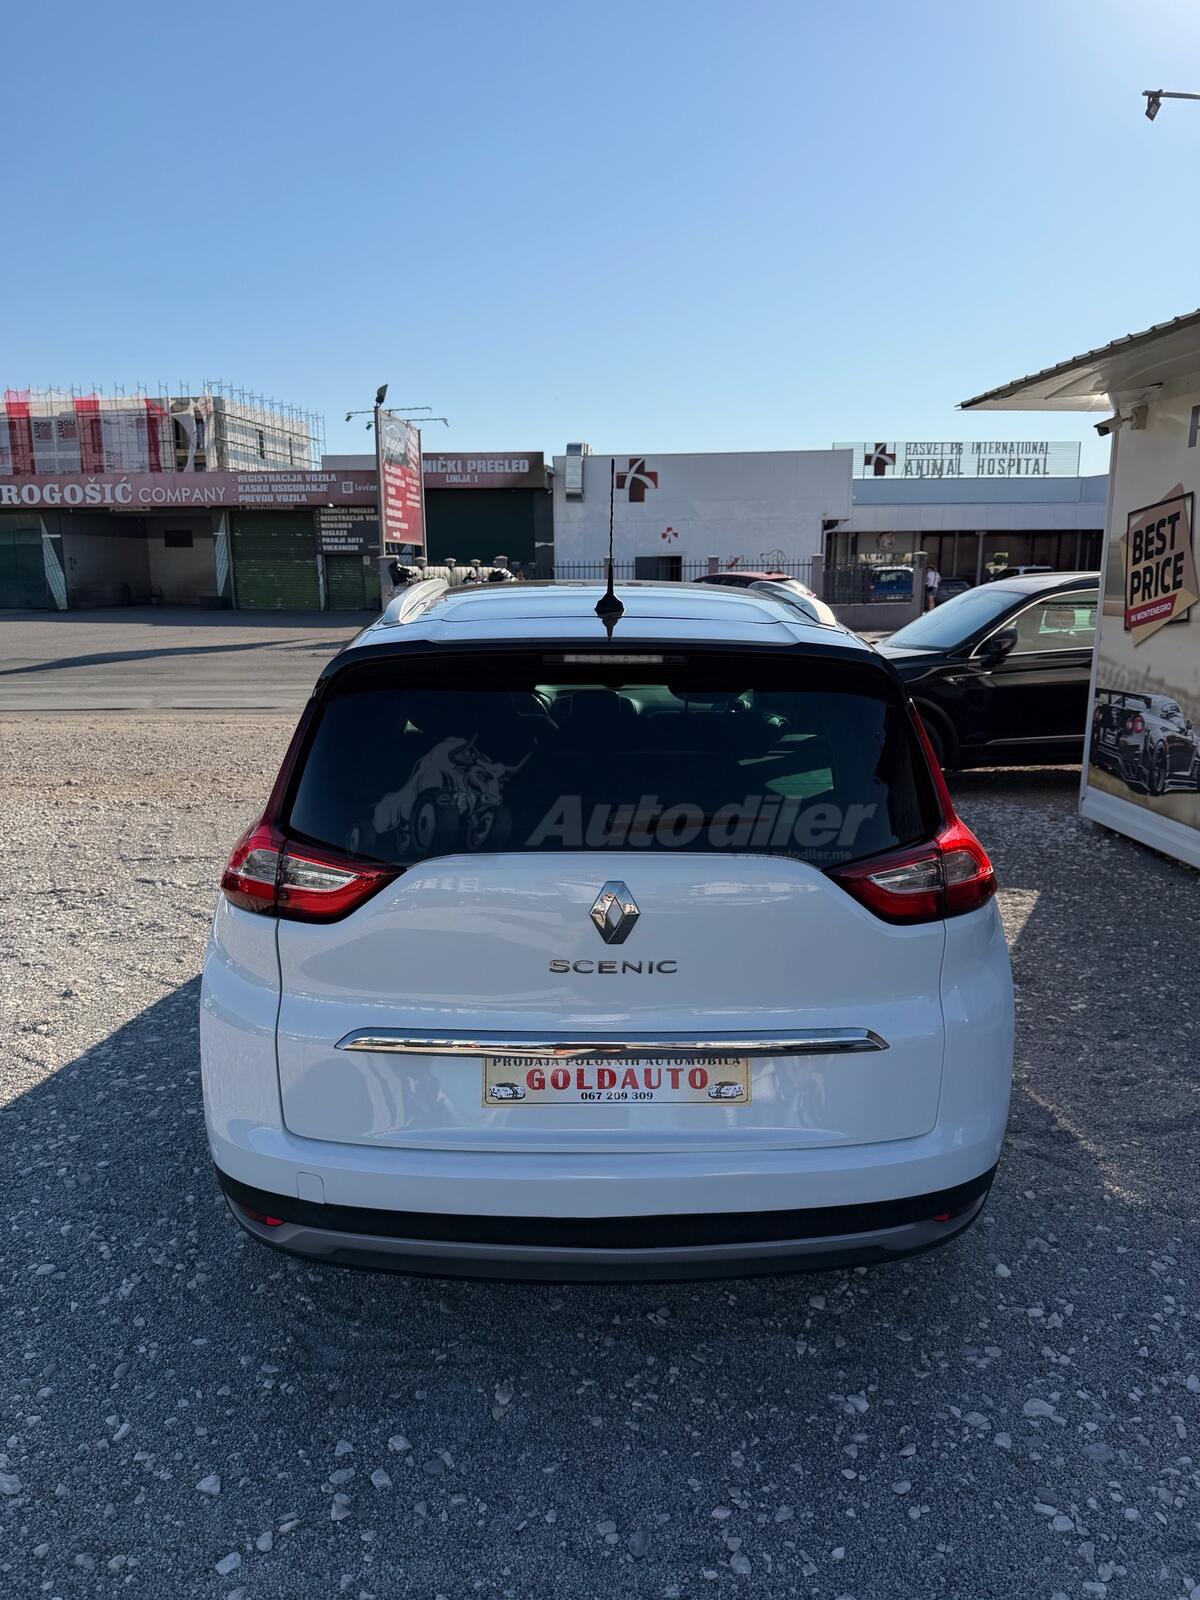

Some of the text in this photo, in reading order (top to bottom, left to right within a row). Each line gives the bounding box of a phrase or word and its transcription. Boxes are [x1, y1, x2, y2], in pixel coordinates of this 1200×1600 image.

[971, 442, 1051, 454] INTERNATIONAL
[423, 456, 530, 473] NIČKI PREGLED
[905, 459, 1050, 475] ANIMAL HOSPITAL
[238, 474, 337, 482] REGISTRACIJA VOZILA
[0, 476, 227, 505] ROGOŠIĆ COMPANY
[238, 484, 329, 493] KASKO OSIGURANJE
[276, 494, 308, 503] VOZILA
[1132, 511, 1181, 566] BEST
[1129, 551, 1185, 606] PRICE
[1136, 602, 1172, 621] MONTENEGRO
[549, 959, 679, 975] SCENIC
[492, 1058, 560, 1067] PRODAJA
[645, 1057, 741, 1067] AUTOMOBILA
[526, 1067, 709, 1090] GOLDAUTO
[581, 1092, 654, 1100] 067 209 309
